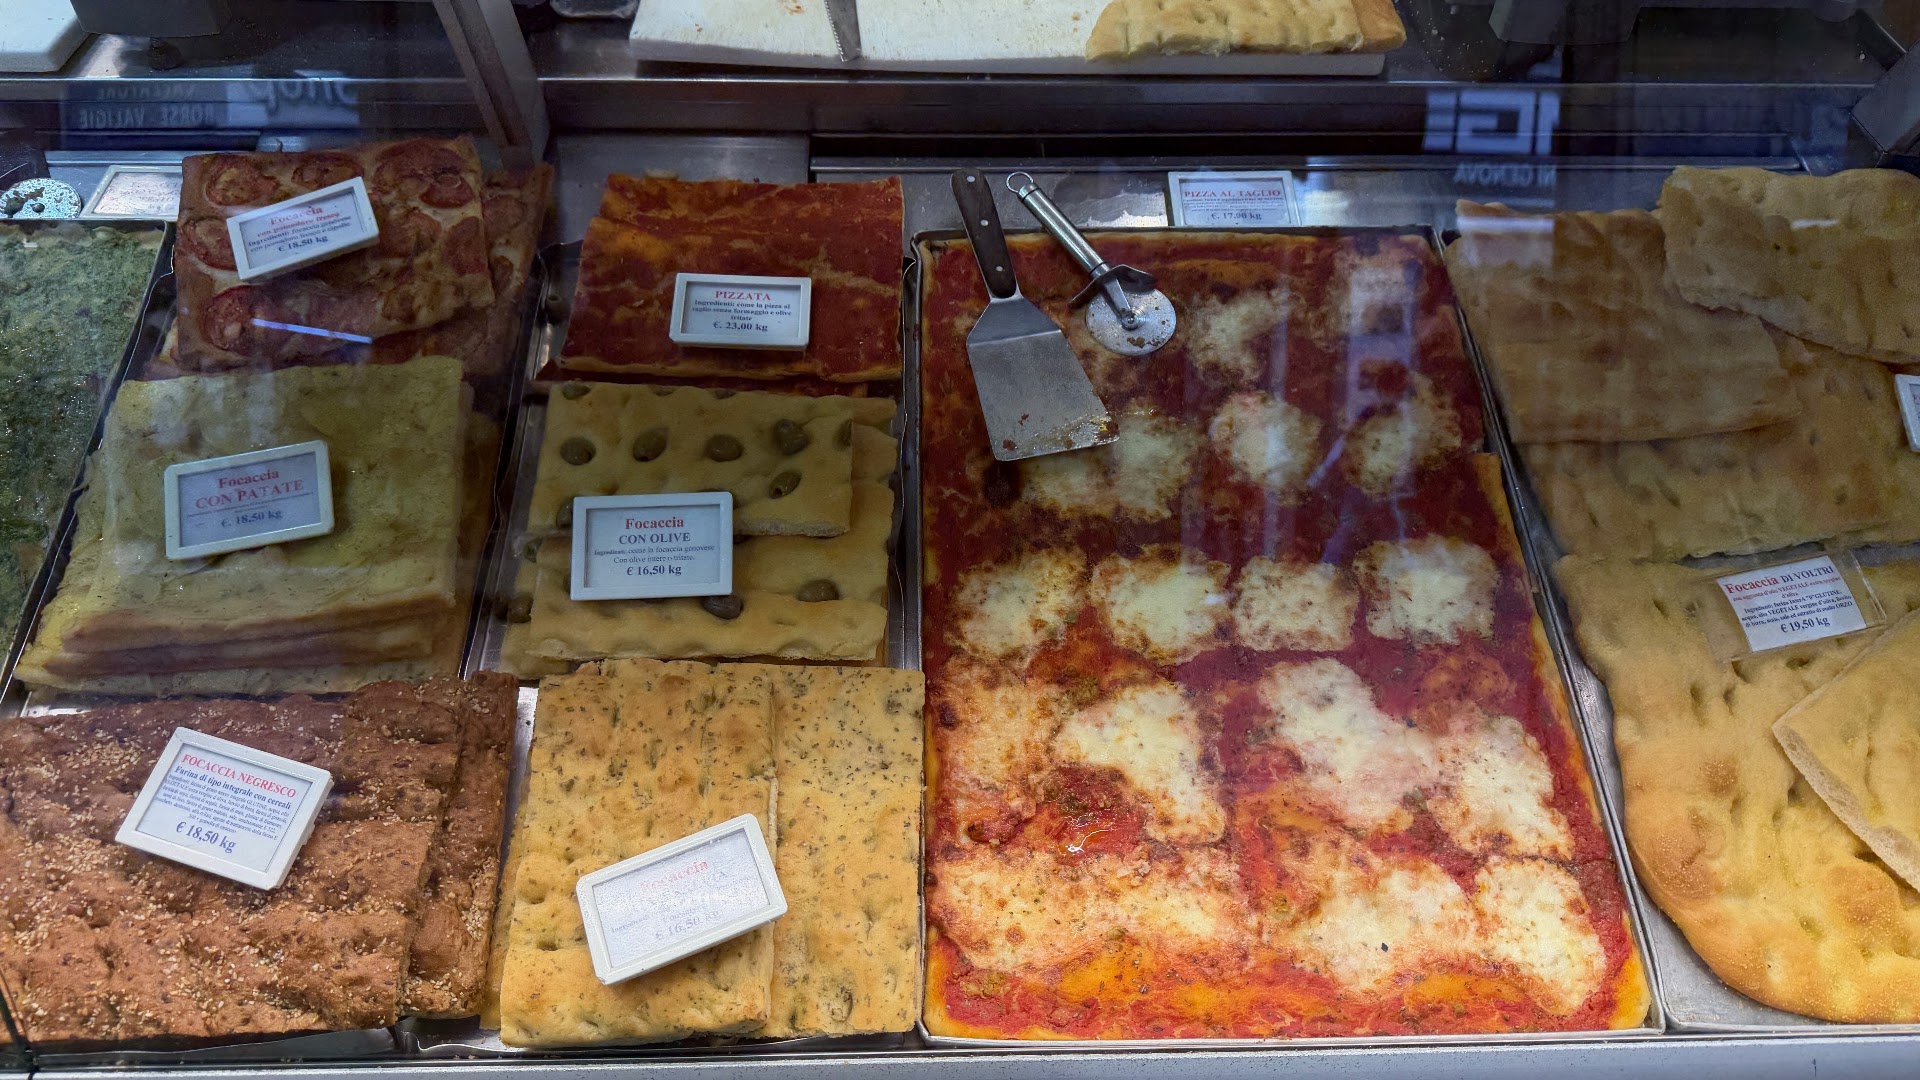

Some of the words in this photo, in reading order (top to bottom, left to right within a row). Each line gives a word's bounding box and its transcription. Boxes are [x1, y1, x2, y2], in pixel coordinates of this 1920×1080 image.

[715, 291, 771, 300] PIZZATA
[756, 323, 768, 331] kg
[218, 469, 279, 488] Focaccia
[196, 493, 232, 508] CON
[235, 480, 304, 501] PATATE
[625, 517, 684, 529] Focaccia
[619, 535, 645, 544] CON
[650, 532, 690, 543] OLIVE
[627, 567, 632, 575] €
[638, 565, 664, 575] 16,50
[669, 565, 681, 575] kg
[1724, 577, 1779, 594] Focaccia
[1780, 574, 1793, 583] DI
[1793, 566, 1834, 579] VOLTRI
[1781, 624, 1786, 632] €
[1789, 619, 1814, 631] 19,50
[1815, 617, 1830, 626] kg
[181, 754, 235, 778] FOCACCIA
[237, 772, 296, 797] NEGRESCO
[174, 766, 198, 779] Farina
[208, 777, 221, 786] tipo
[222, 781, 252, 797] integrale
[267, 798, 292, 809] cereali
[176, 822, 186, 832] €
[186, 825, 219, 844] 18,50
[219, 836, 235, 853] kg
